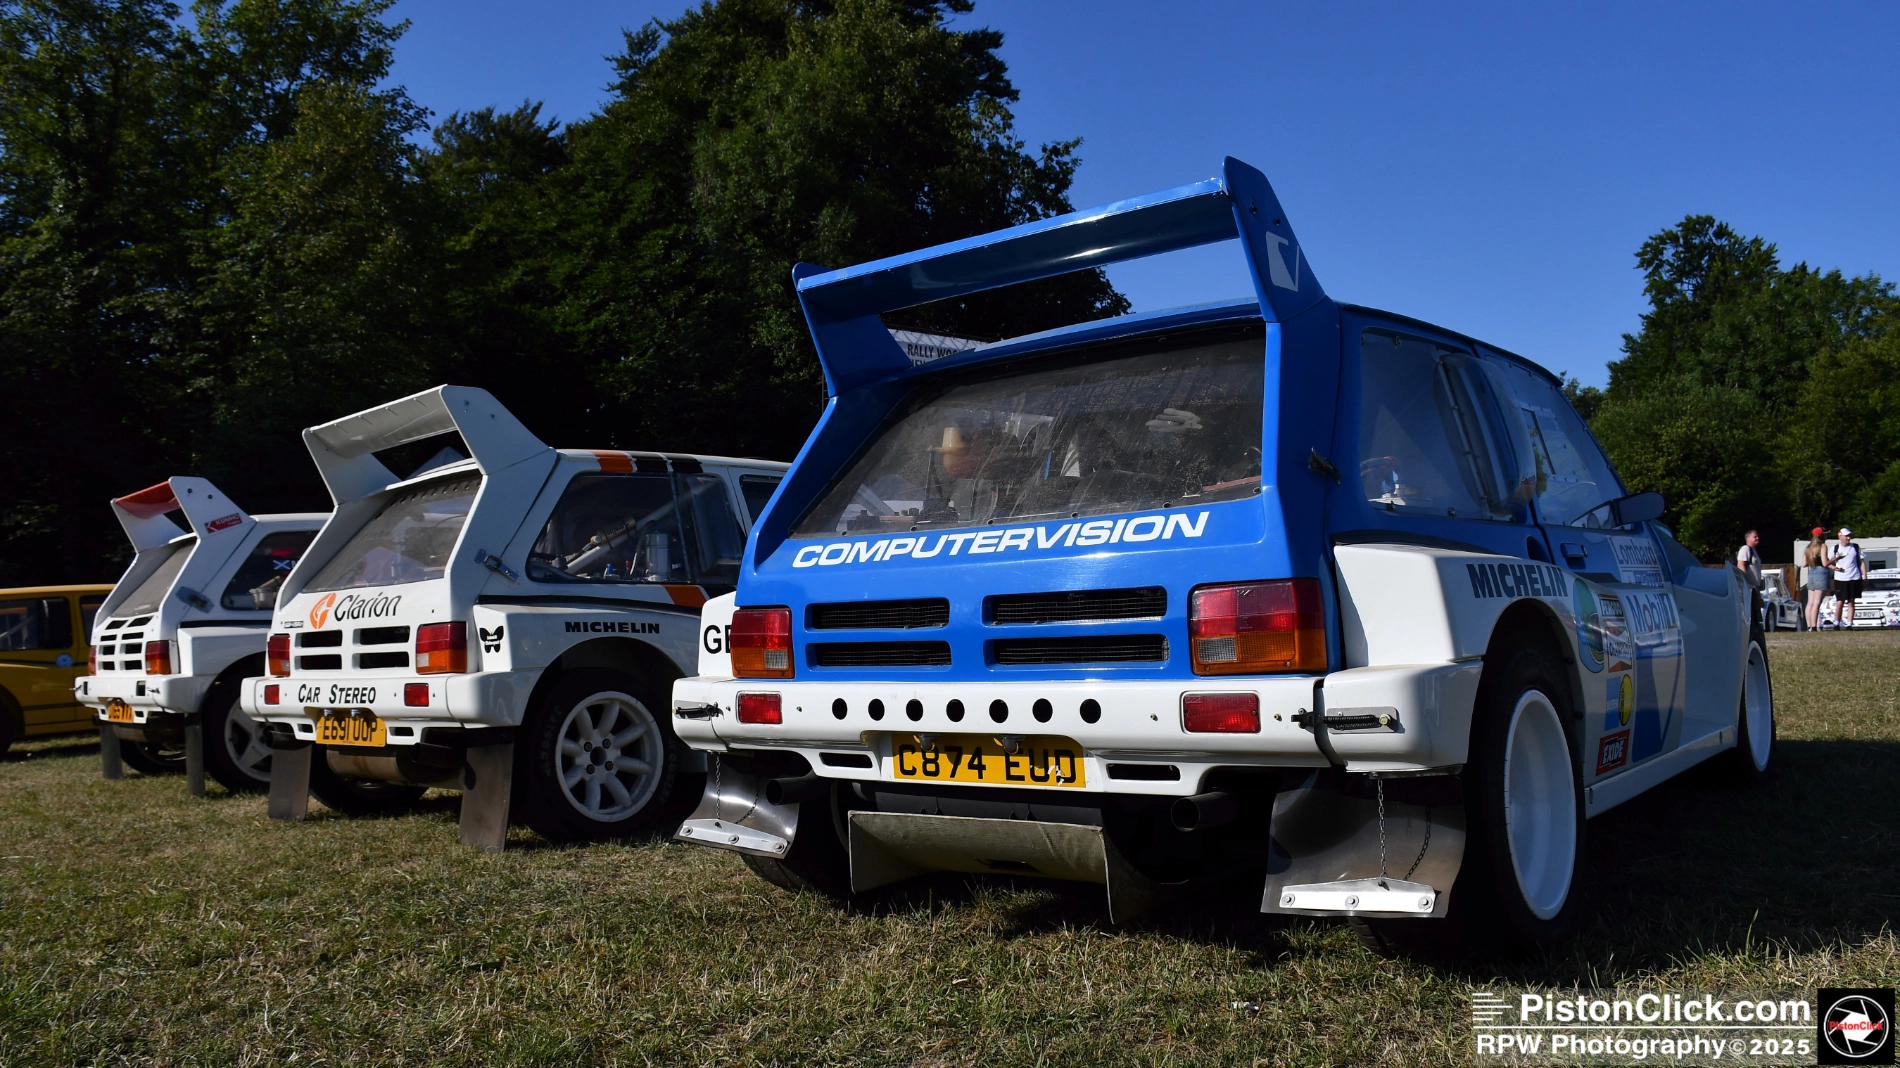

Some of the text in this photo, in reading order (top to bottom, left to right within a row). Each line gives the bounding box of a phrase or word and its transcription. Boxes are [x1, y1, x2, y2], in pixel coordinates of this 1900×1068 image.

[907, 343, 934, 359] RALLY
[215, 514, 240, 525] KUMHO
[791, 510, 1211, 569] COMPUTERVISION
[1609, 537, 1658, 566] Lombard
[1466, 562, 1568, 599] MICHELIN
[334, 592, 402, 622] Clarion
[1601, 599, 1624, 617] FERODO
[564, 621, 660, 634] MICHELIN
[298, 683, 376, 704] CAR STEREO
[323, 717, 350, 741] E691
[898, 744, 1077, 784] C874 EUD
[1602, 739, 1625, 765] EXIDE
